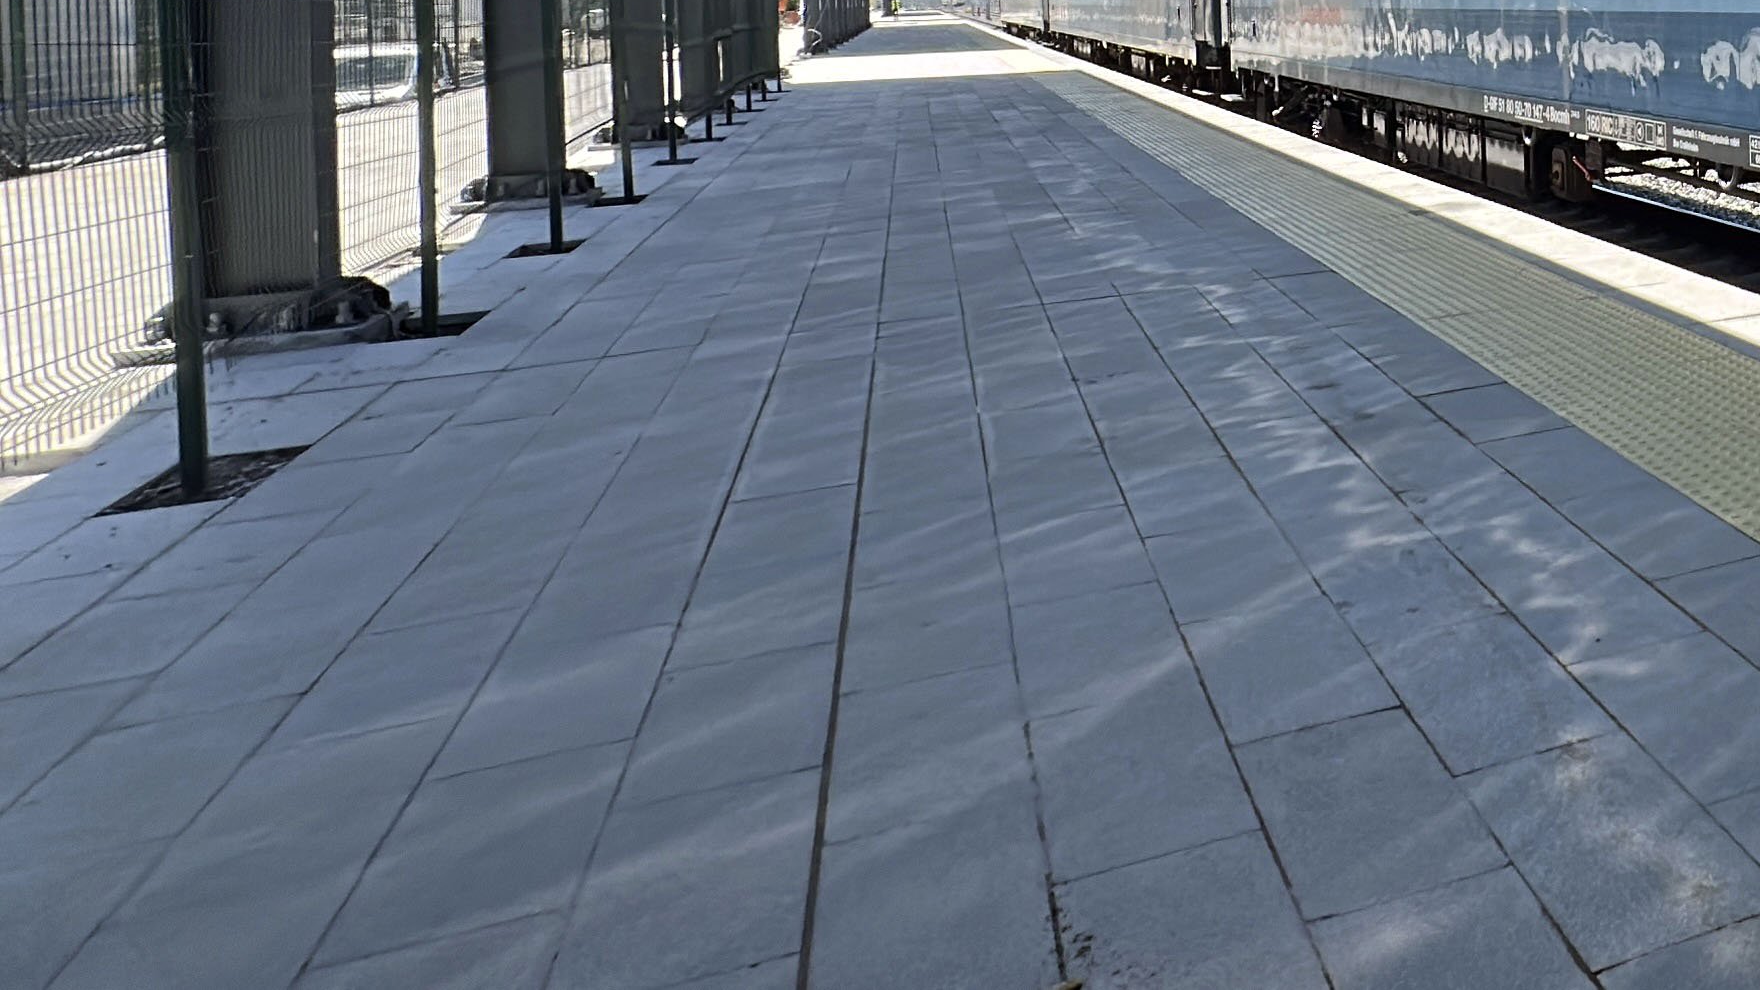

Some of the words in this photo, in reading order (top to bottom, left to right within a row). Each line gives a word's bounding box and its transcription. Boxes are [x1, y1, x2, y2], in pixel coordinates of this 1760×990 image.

[1498, 97, 1505, 113] 51
[1506, 98, 1514, 115] 80
[1587, 113, 1600, 132] 160
